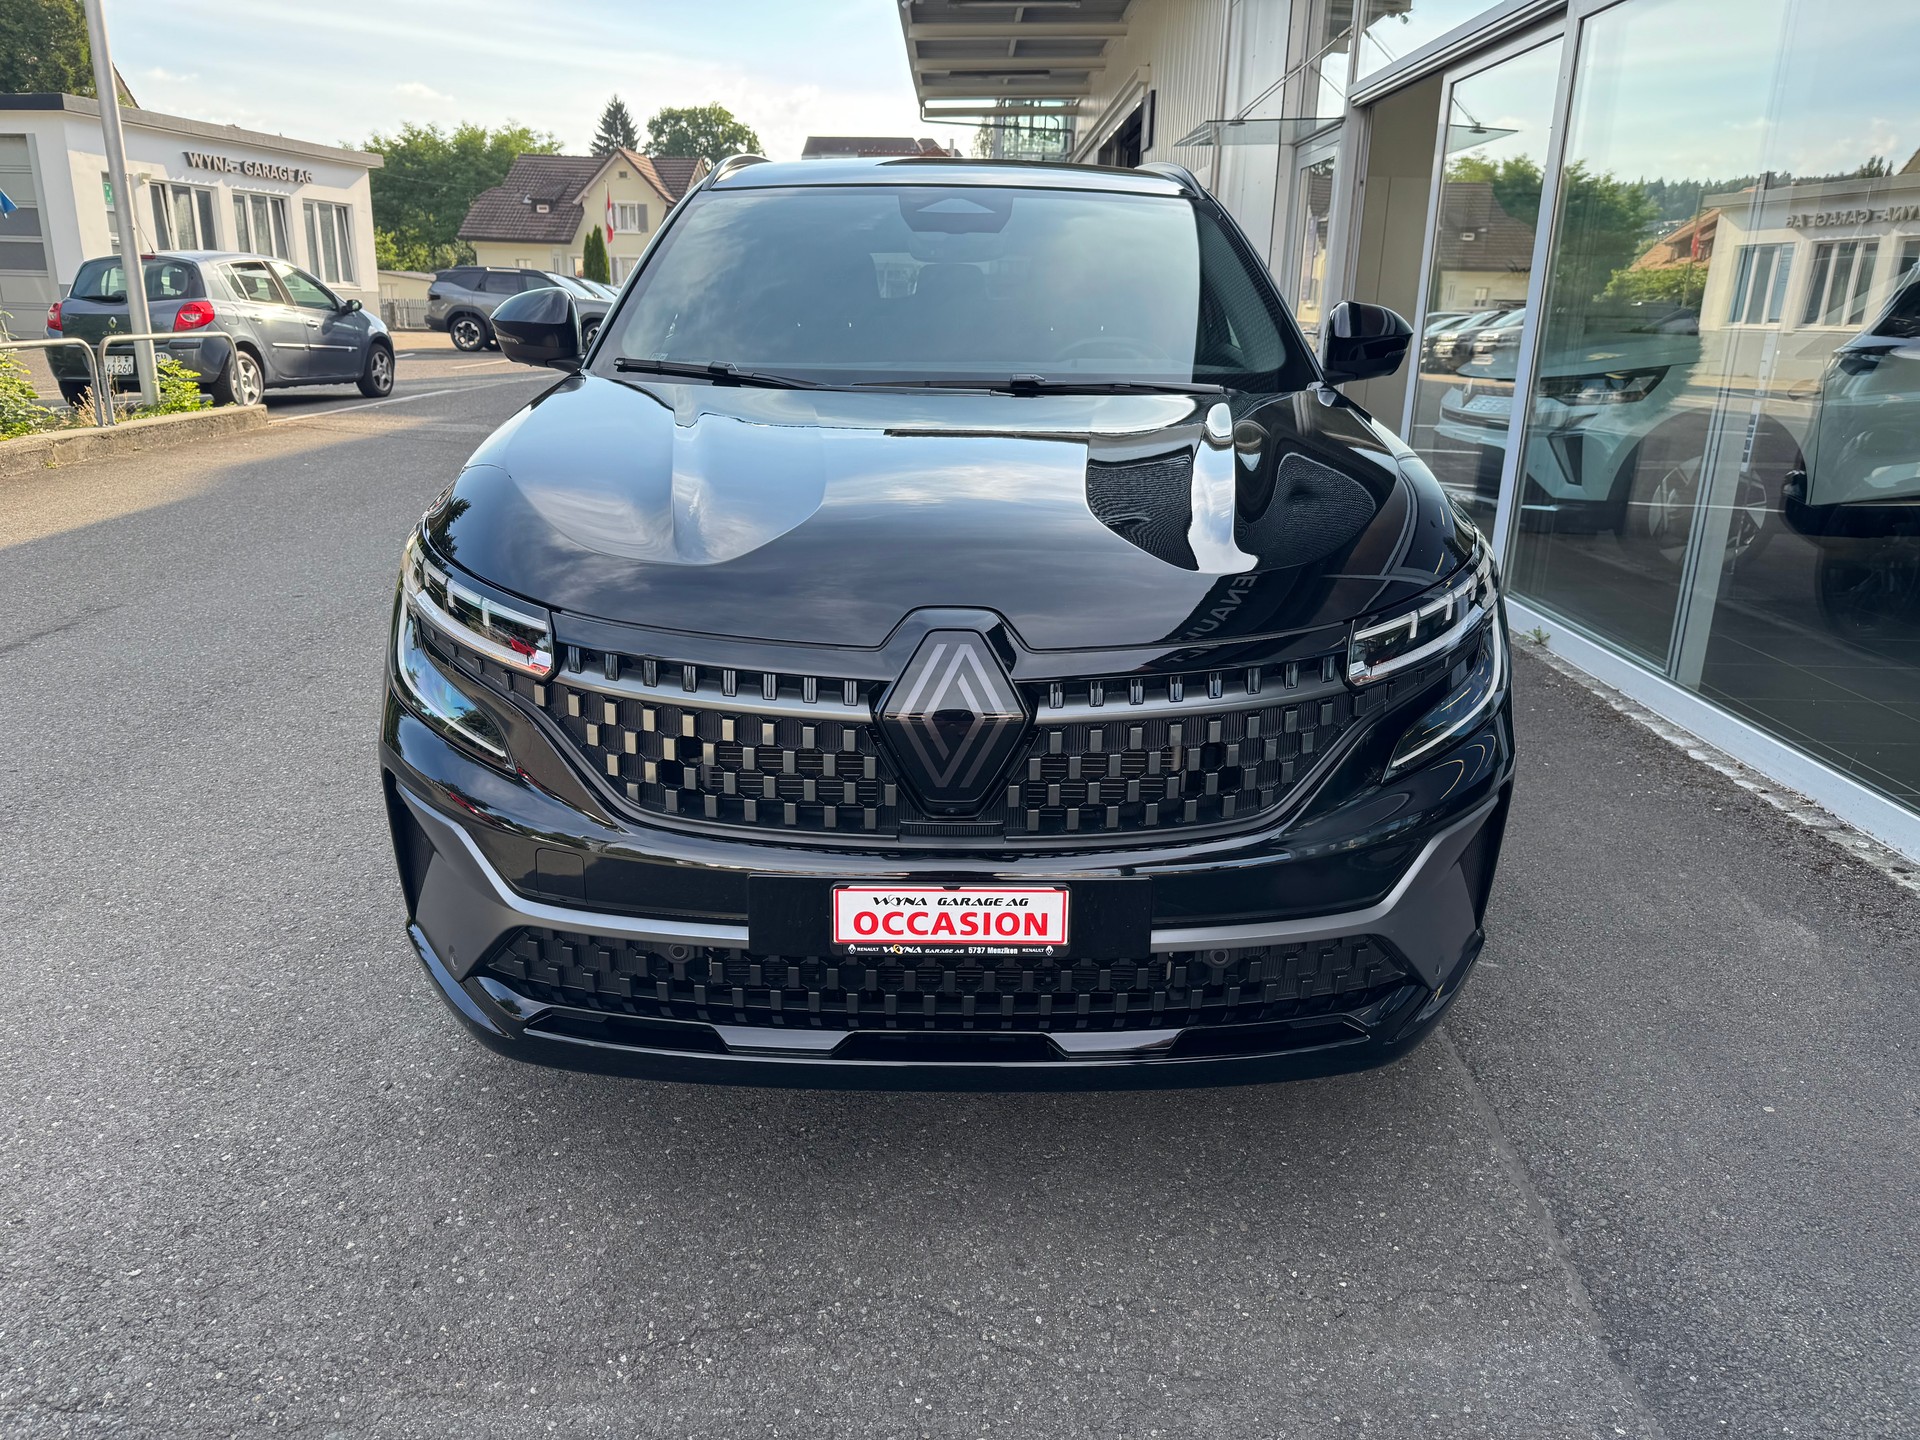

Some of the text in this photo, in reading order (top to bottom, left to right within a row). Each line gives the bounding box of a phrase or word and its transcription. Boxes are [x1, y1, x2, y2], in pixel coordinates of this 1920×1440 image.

[242, 160, 296, 183] GARAGE
[297, 168, 313, 184] AG
[872, 894, 1030, 907] WYNA GARAGE AG
[853, 911, 1048, 937] OCCASION
[882, 944, 923, 955] WYNA
[968, 946, 985, 954] 5737
[987, 947, 1018, 955] Menziken
